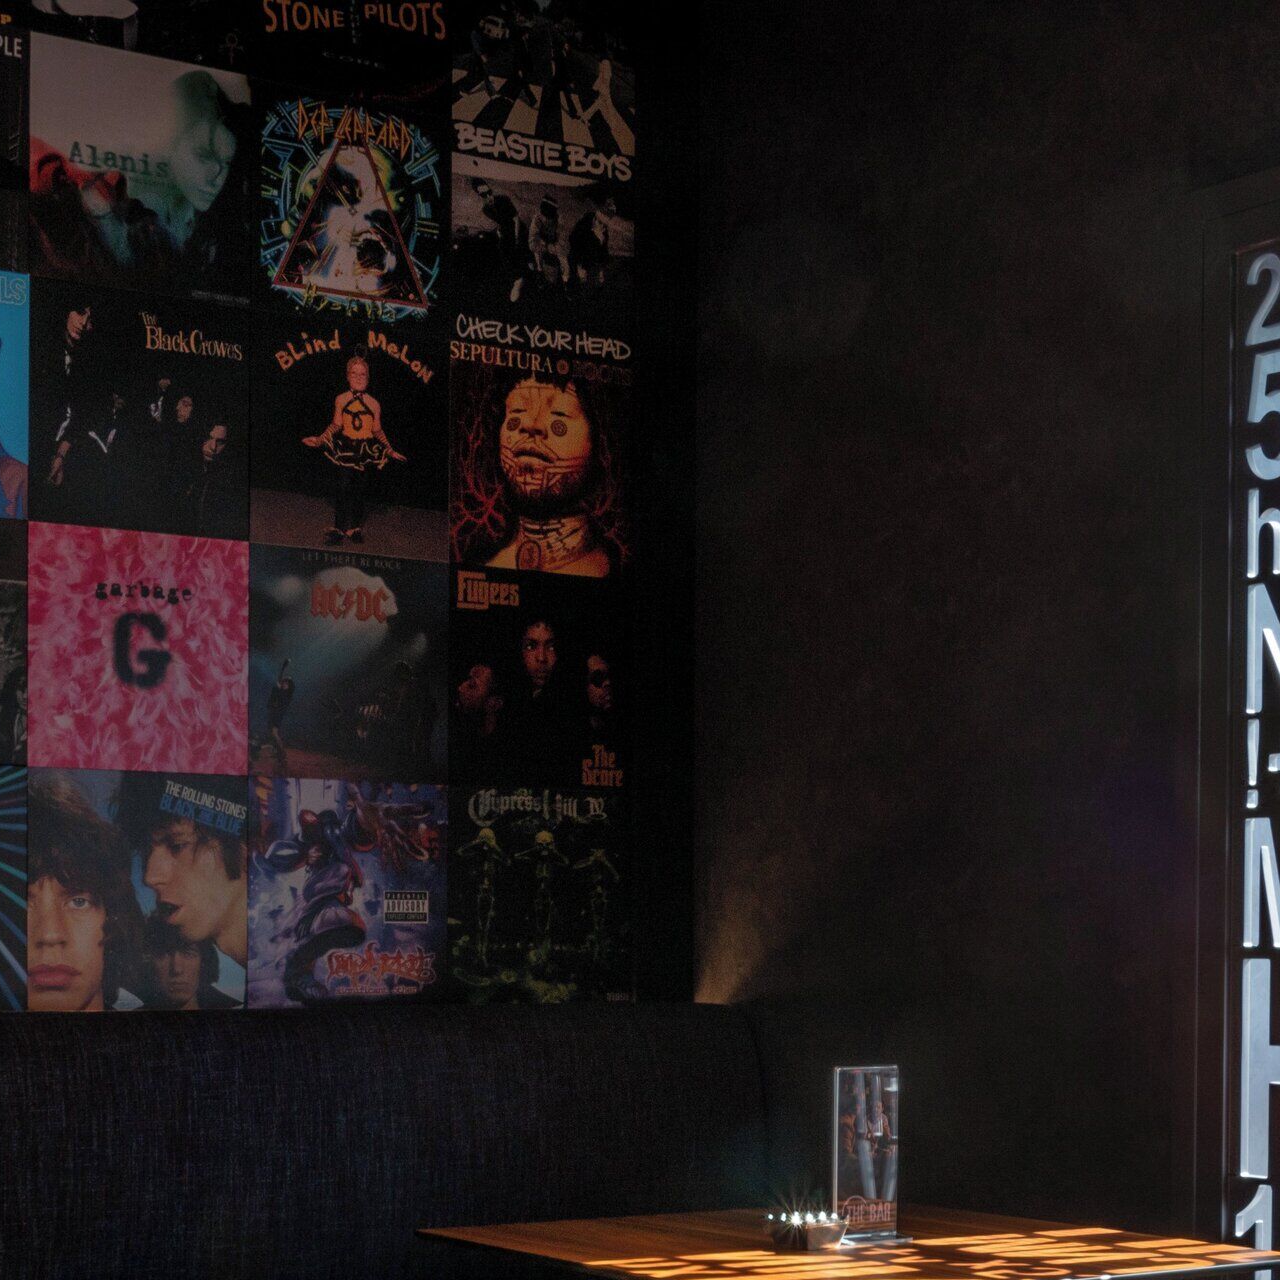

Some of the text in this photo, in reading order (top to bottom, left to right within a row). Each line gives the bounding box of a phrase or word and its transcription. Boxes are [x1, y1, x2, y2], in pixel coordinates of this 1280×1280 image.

[261, 0, 447, 41] STONE PILOTS
[334, 104, 415, 160] LEPPARD
[70, 140, 169, 179] Alanis
[453, 121, 633, 183] BEASTIE BOYS
[145, 325, 190, 354] Black
[189, 328, 243, 362] Crowes
[456, 312, 632, 361] CHECK YOUR HEAD
[449, 339, 554, 374] SEPULTURA
[95, 582, 192, 605] garbage
[114, 612, 171, 688] G
[581, 758, 625, 788] Score
[591, 743, 617, 768] The
[181, 785, 216, 809] ROLLING
[215, 797, 248, 820] STONES
[385, 900, 427, 912] ADVISORY
